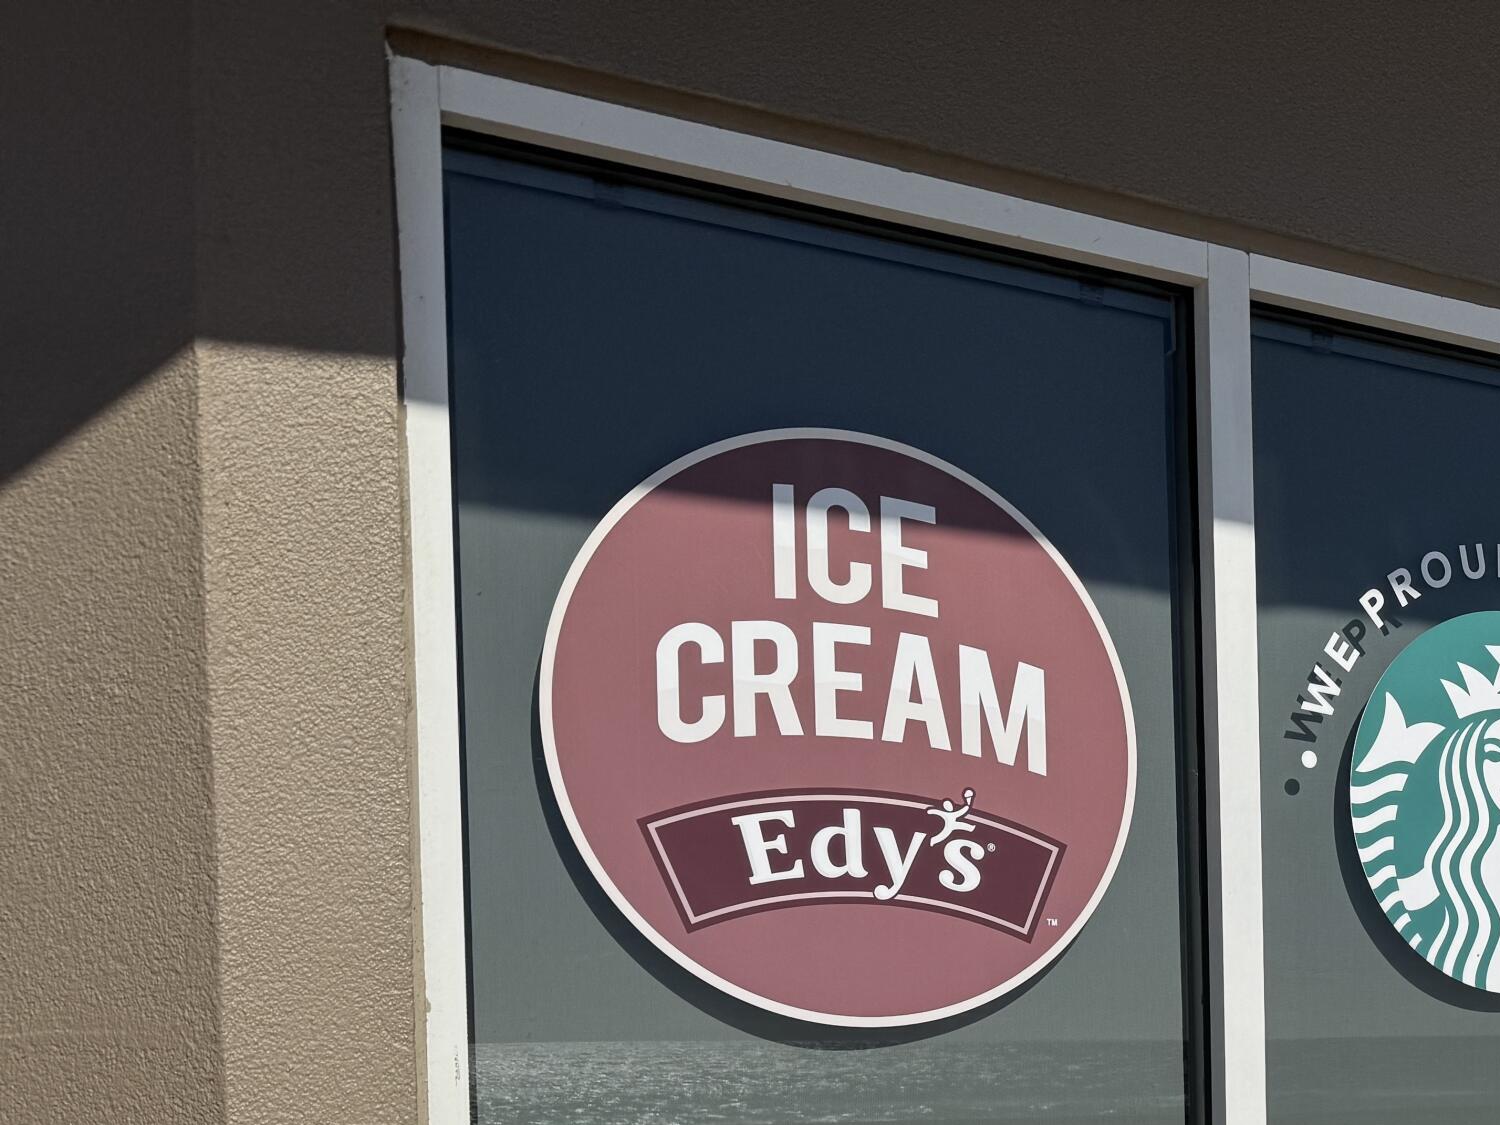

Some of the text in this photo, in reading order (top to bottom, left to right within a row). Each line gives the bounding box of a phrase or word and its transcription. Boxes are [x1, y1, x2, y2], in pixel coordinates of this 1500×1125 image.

[772, 483, 939, 618] ICE
[655, 620, 1048, 777] CREAM
[1300, 631, 1361, 716] WE
[731, 800, 985, 900] Edy's
[1046, 918, 1058, 927] TM
